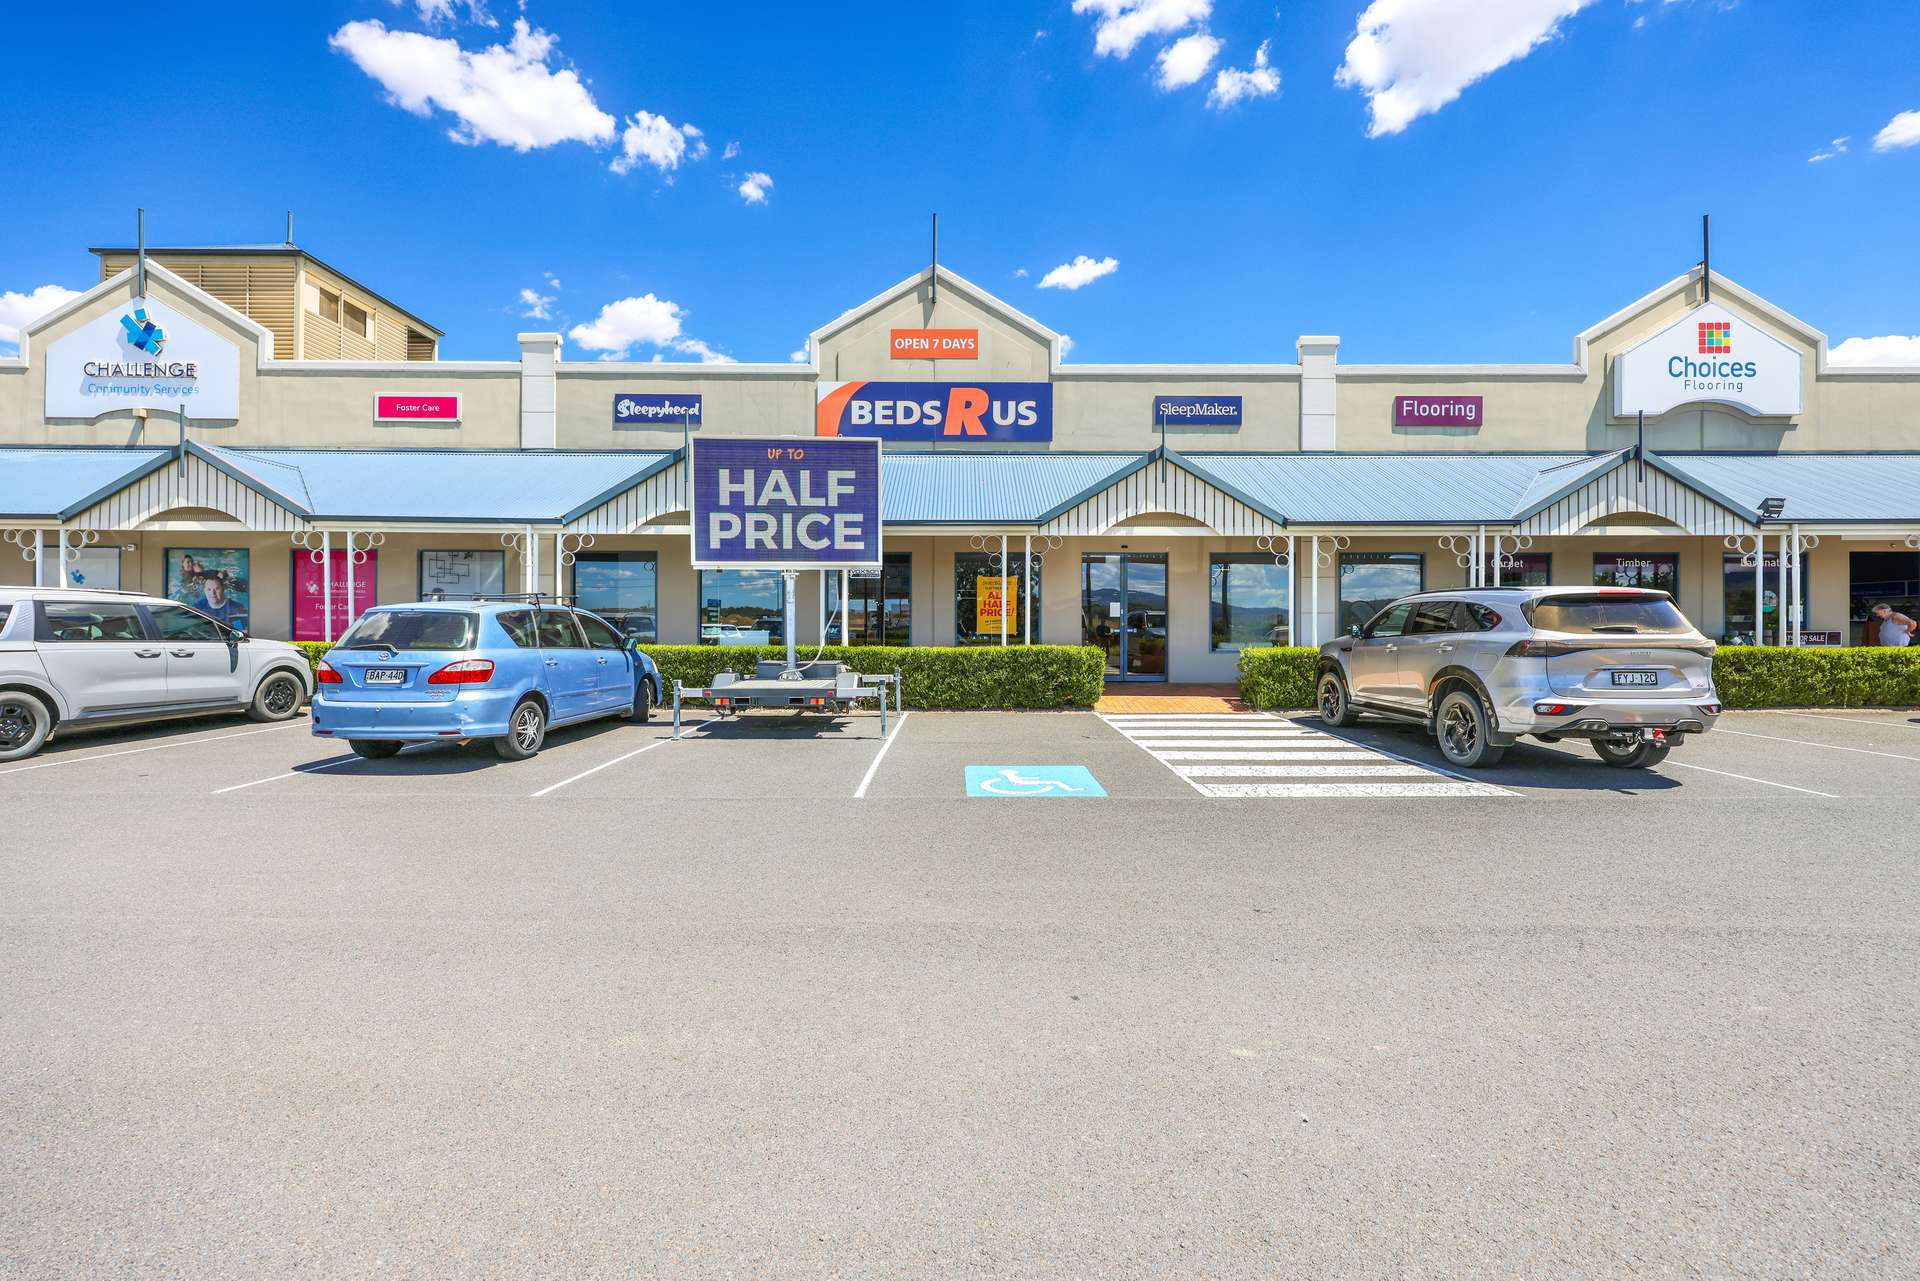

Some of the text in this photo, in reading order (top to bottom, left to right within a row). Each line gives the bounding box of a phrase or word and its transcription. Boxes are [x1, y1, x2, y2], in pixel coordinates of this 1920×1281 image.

[895, 338, 975, 349] OPEN 7 DAYS
[83, 361, 196, 378] CHALLENGE
[1668, 355, 1757, 378] Choices
[87, 383, 199, 395] Community Services
[1684, 379, 1743, 393] Flooring
[396, 403, 440, 412] Foster Care
[617, 399, 699, 418] Sleepyhead
[851, 387, 1038, 436] BEDS R US
[1403, 400, 1475, 420] Flooring
[767, 448, 804, 460] UP TO
[718, 468, 856, 507] HALF
[709, 512, 865, 551] PRICE
[1616, 557, 1652, 568] Timber
[988, 592, 1003, 600] AL
